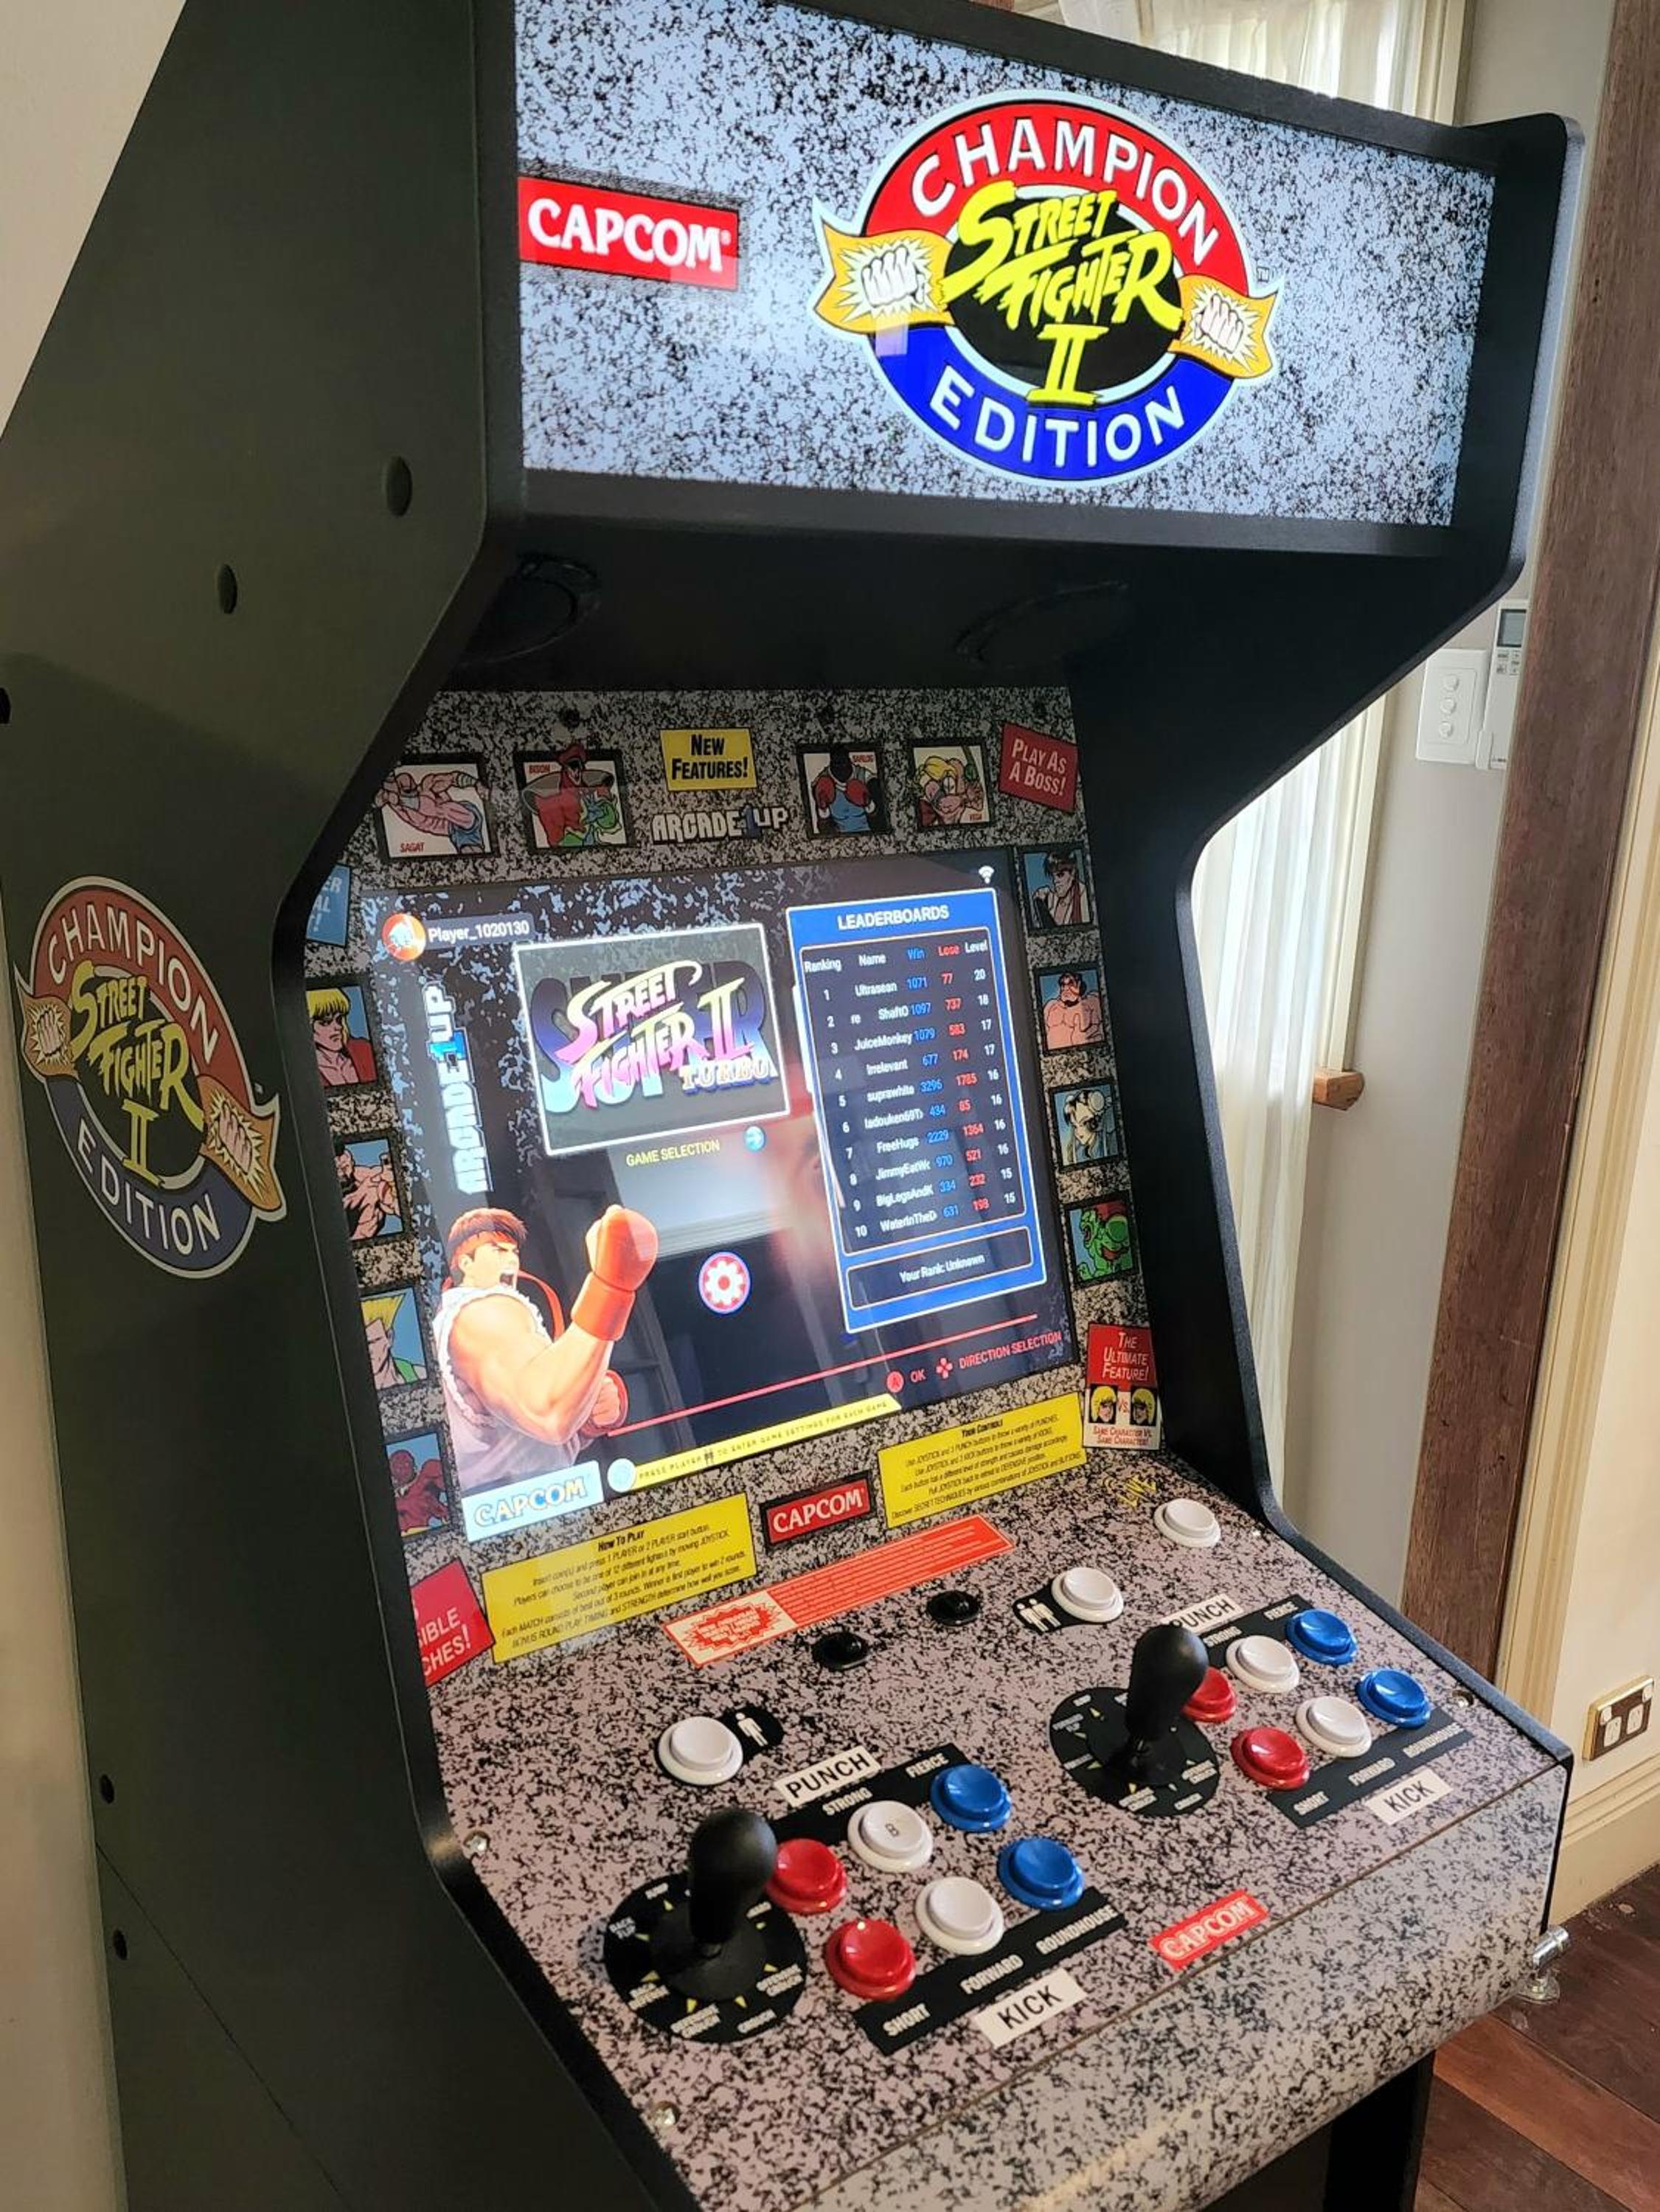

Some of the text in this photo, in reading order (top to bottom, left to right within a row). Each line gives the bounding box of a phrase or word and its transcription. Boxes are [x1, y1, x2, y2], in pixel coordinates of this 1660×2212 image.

[913, 118, 1220, 267] CHAMPION
[527, 196, 724, 273] CAPCOM
[940, 181, 1118, 289] STREET
[977, 227, 1183, 330] FIGHTER
[1031, 323, 1108, 406] II
[930, 368, 1186, 468] EDITION
[690, 734, 726, 756] NEW
[1011, 738, 1067, 774] PLAY AS
[671, 757, 749, 780] FEATURES!
[1008, 760, 1066, 797] A BOSS!
[400, 842, 426, 854] SAGAT
[428, 920, 530, 945] Player_1020130
[837, 904, 950, 931] LEADERBOARDS
[804, 939, 988, 974] Ranking Name Win Lose Level
[47, 903, 220, 1064] CHAMPION
[822, 988, 830, 1001] 1
[941, 972, 954, 985] 77
[973, 968, 987, 981] 20
[68, 960, 148, 1063] STREET
[554, 960, 703, 1065] STREET
[826, 1015, 835, 1027] 2
[977, 994, 990, 1005] 18
[572, 977, 754, 1108] FIGHTER II
[830, 1041, 839, 1055] 3
[981, 1018, 993, 1030] 17
[86, 1019, 204, 1132] FIGHTER
[678, 1057, 771, 1095] TURBO
[833, 1068, 842, 1081] 4
[984, 1043, 996, 1056] 17
[838, 1095, 847, 1108] 5
[987, 1069, 999, 1081] 16
[841, 1121, 850, 1134] 6
[990, 1093, 1003, 1106] 16
[122, 1098, 164, 1188] II
[625, 1140, 721, 1168] GAME SELECTION
[845, 1146, 854, 1159] 7
[994, 1117, 1006, 1131] 16
[997, 1142, 1010, 1155] 16
[77, 1118, 221, 1255] EDITION
[852, 1199, 861, 1213] 9
[1000, 1166, 1013, 1179] 15
[854, 1224, 868, 1238] 10
[1003, 1191, 1016, 1204] 15
[898, 1269, 920, 1284] Your
[945, 1254, 986, 1272] Unknown
[959, 1331, 1063, 1370] DIRECTION SELECTION
[1103, 1346, 1150, 1366] ULTIMATE
[1118, 1331, 1138, 1349] THE
[910, 1368, 926, 1383] OK
[1102, 1362, 1150, 1382] FEATURE!
[473, 1477, 588, 1528] CAPCOM
[772, 1488, 866, 1534] CAPCOM
[1170, 1598, 1236, 1629] PUNCH
[1202, 1625, 1243, 1648] STRONG
[785, 1752, 870, 1799] PUNCH
[822, 1752, 950, 1817] STRONG FIERCE
[1383, 1779, 1434, 1814] KICK
[1160, 1898, 1257, 1960] CAPCOM
[882, 1904, 1119, 2037] SHORT FORWARD ROUNDHOUSE
[996, 1984, 1063, 2030] KICK
